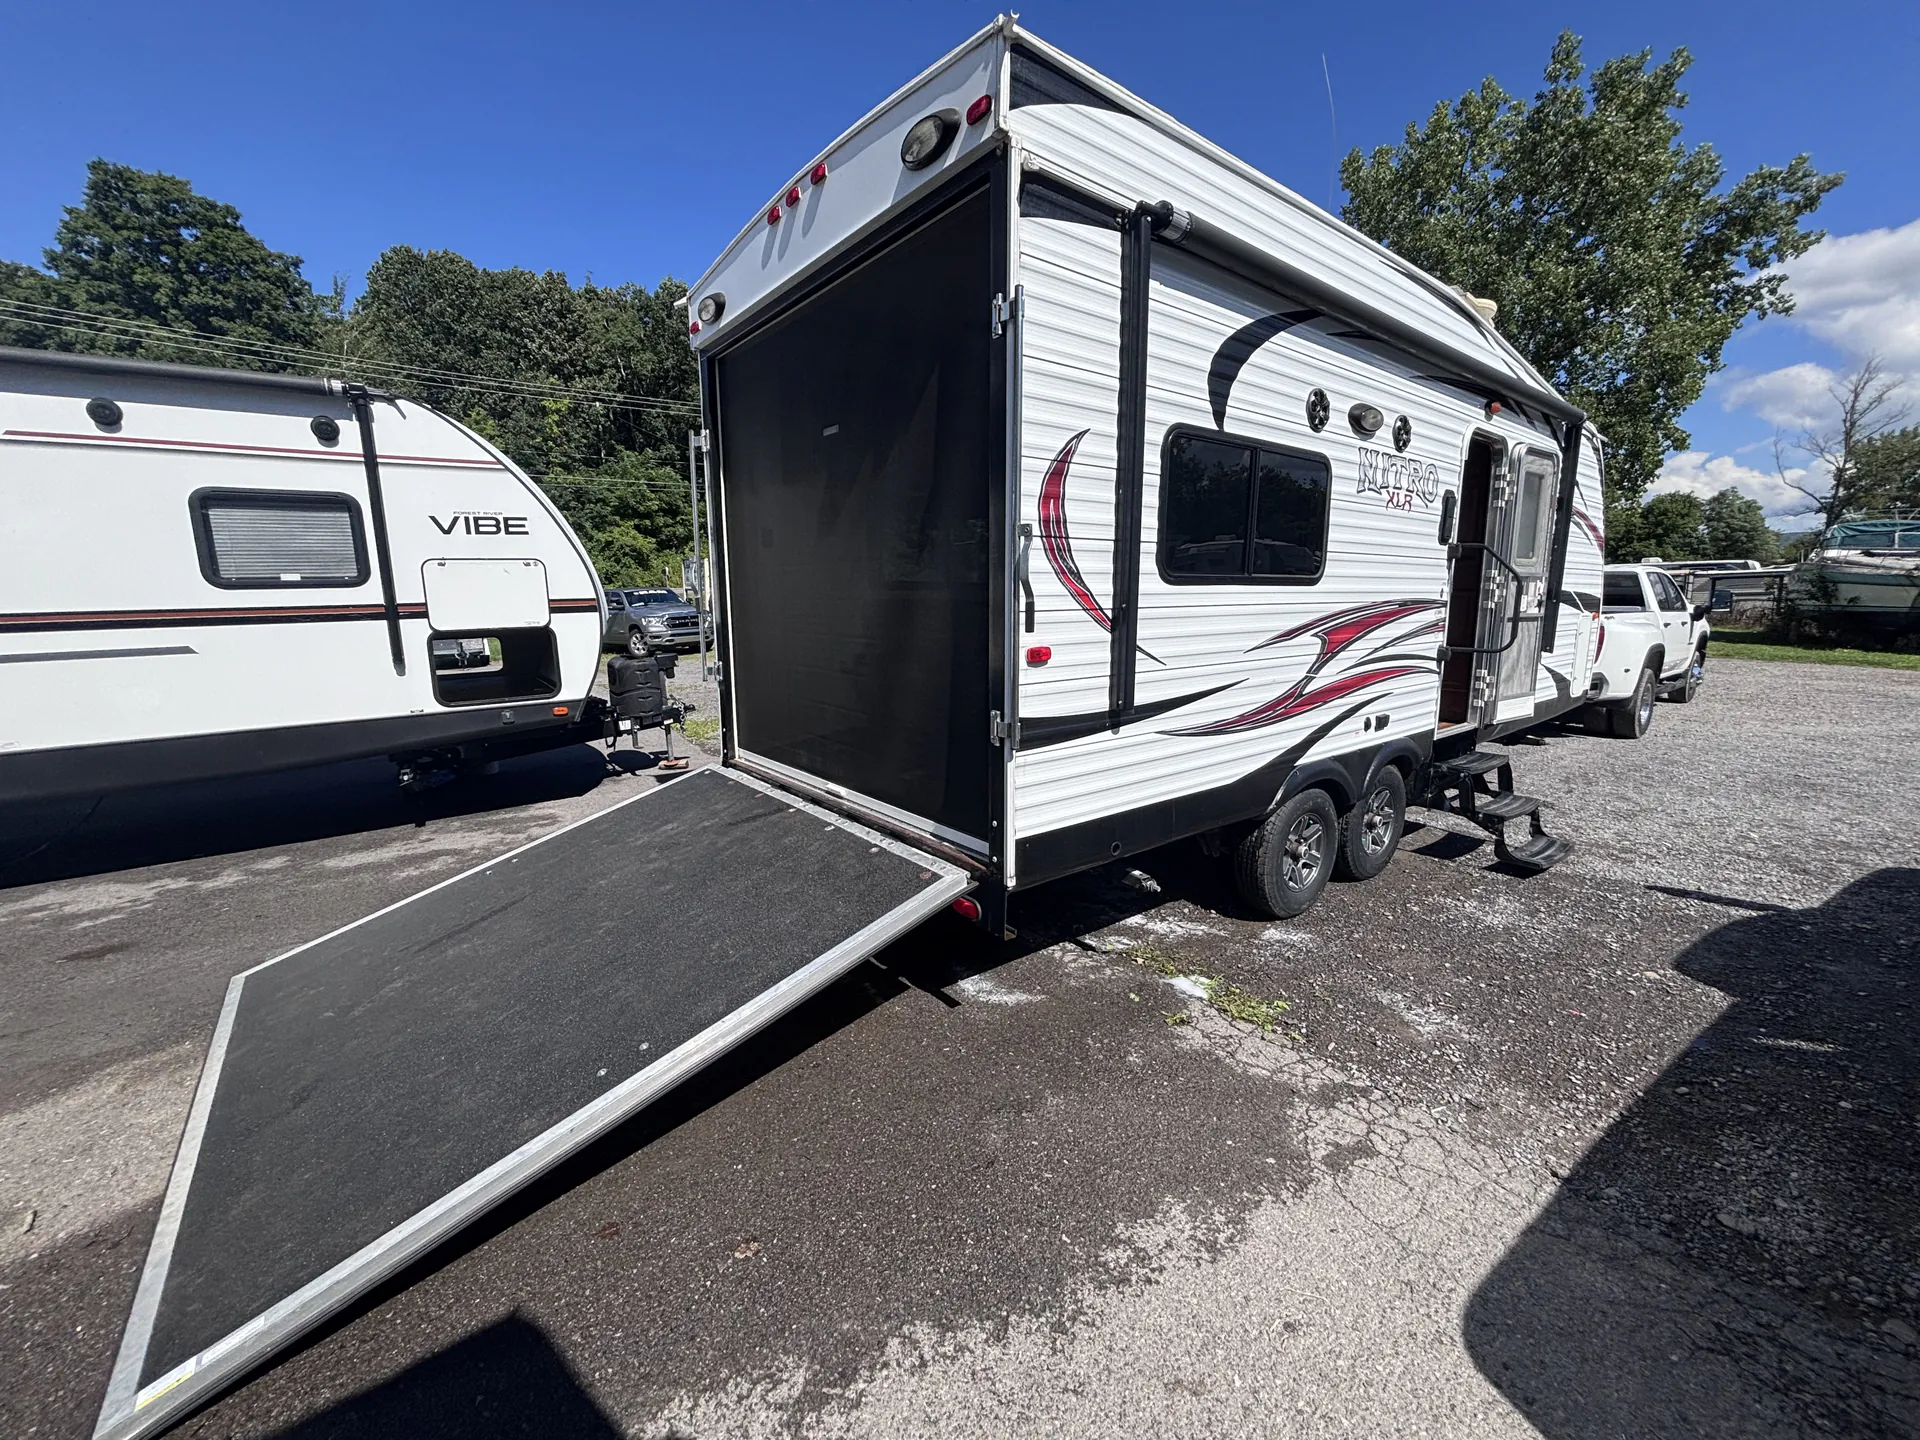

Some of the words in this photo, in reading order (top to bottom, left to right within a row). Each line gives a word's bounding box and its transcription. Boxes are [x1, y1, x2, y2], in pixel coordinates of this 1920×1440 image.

[1357, 447, 1439, 509] NITRO
[1386, 490, 1413, 513] XLR
[428, 515, 529, 535] VIBE
